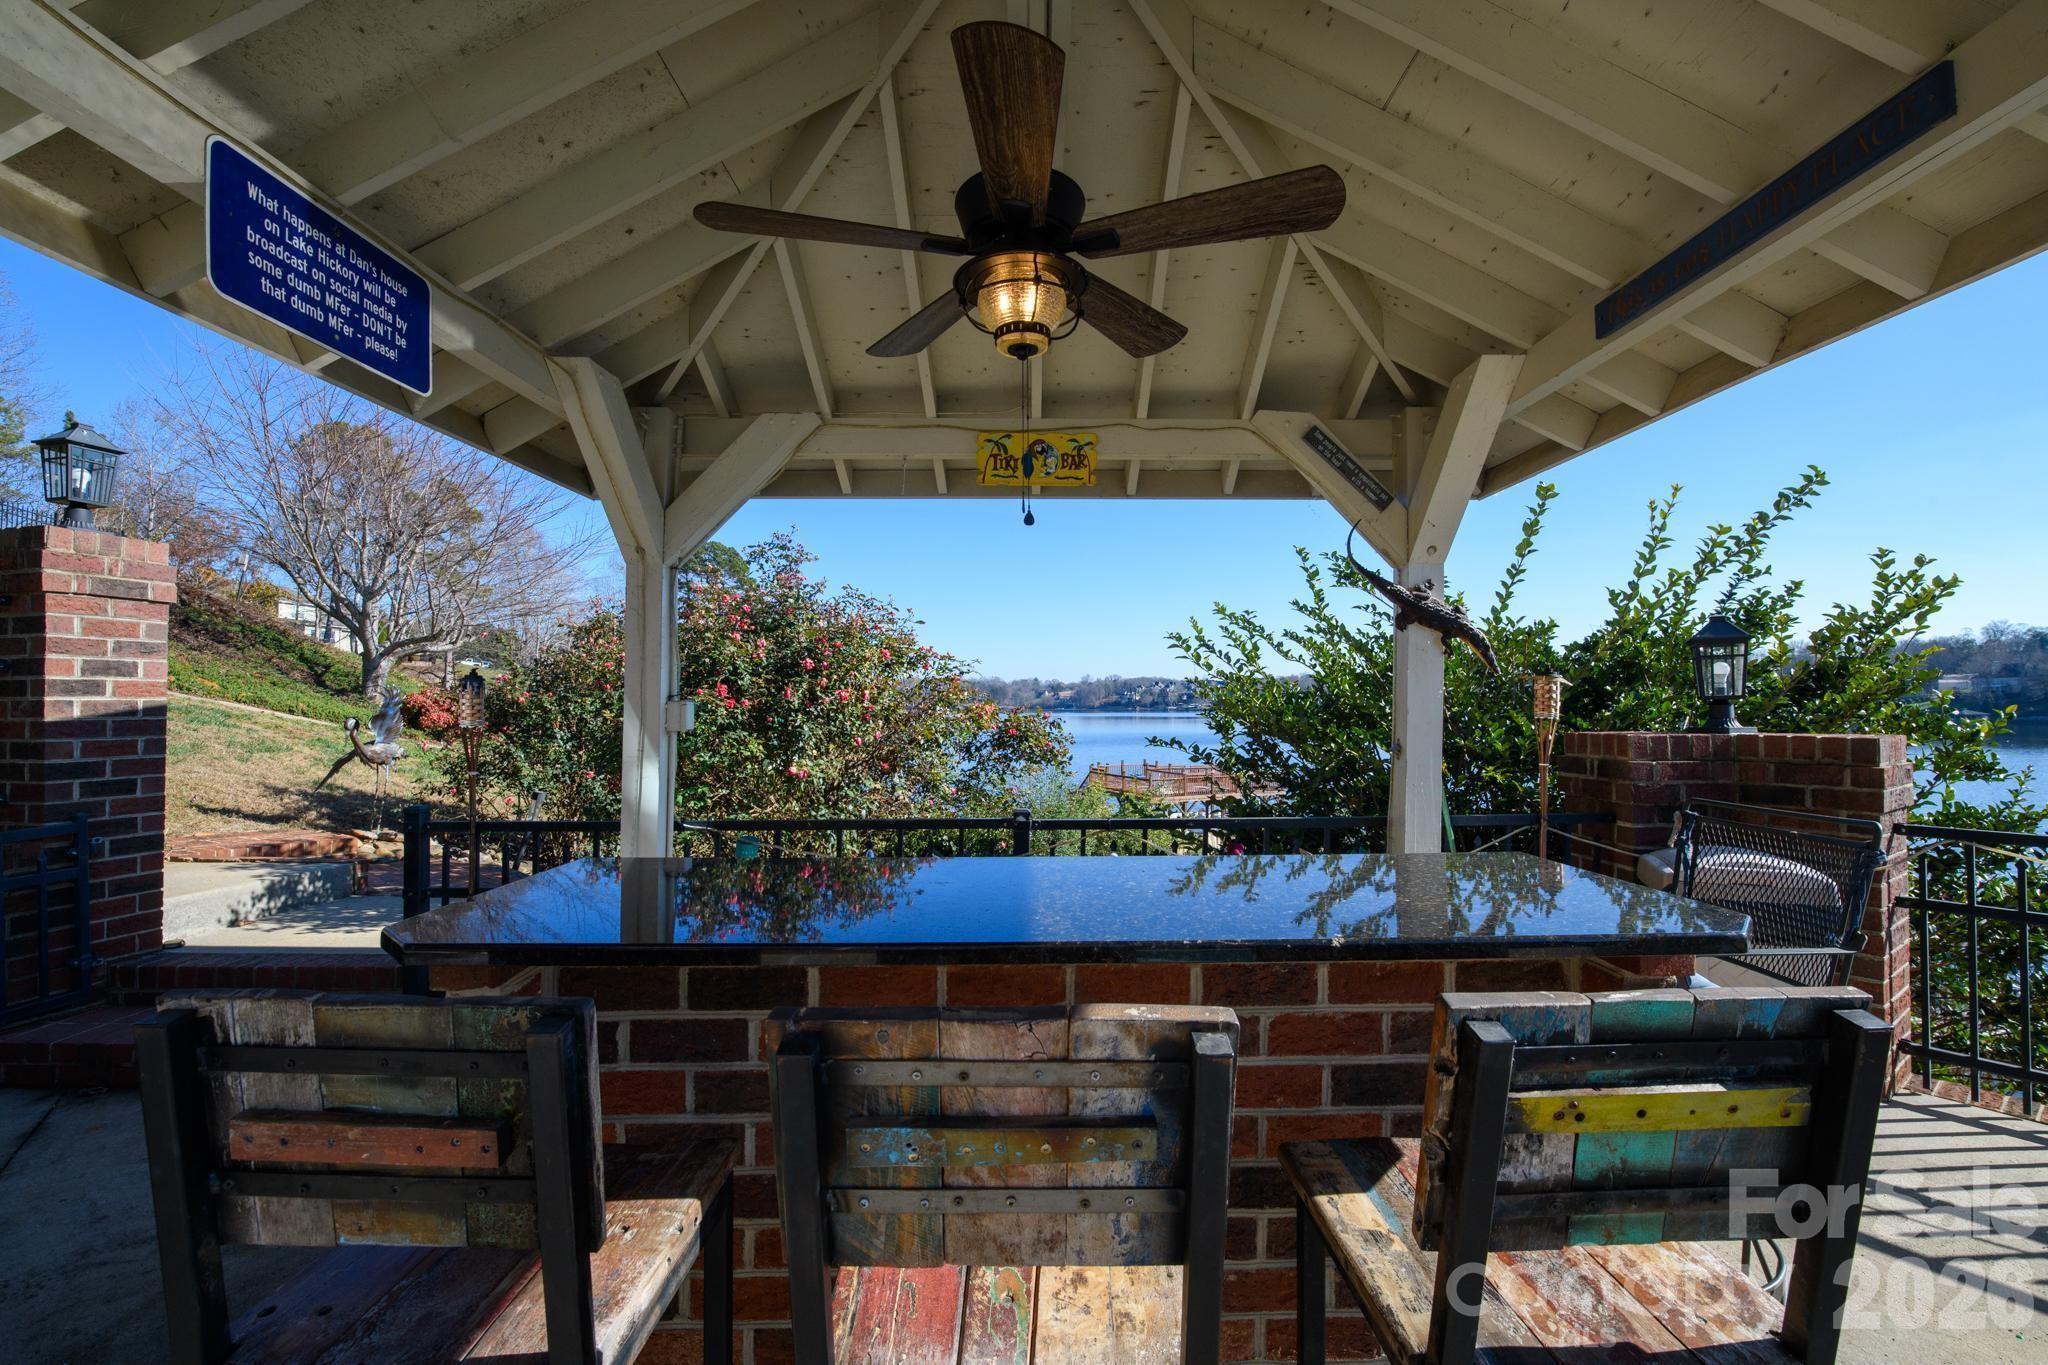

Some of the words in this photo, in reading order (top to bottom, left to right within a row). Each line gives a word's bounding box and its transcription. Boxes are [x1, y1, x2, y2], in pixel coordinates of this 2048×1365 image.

[1810, 94, 1921, 189] PLACE
[247, 225, 308, 275] broadcast
[312, 267, 326, 285] on
[330, 277, 360, 305] social
[363, 297, 393, 324] media
[396, 315, 407, 334] by
[248, 181, 278, 215] What
[284, 206, 332, 248] happens
[335, 242, 346, 258] at
[350, 251, 377, 278] Dan's
[381, 269, 408, 297] house
[264, 219, 280, 237] on
[285, 228, 313, 256] Lake
[318, 248, 359, 286] Hickory
[363, 278, 381, 299] will
[385, 290, 396, 307] be
[248, 252, 283, 280] some
[287, 271, 321, 301] dumb
[325, 296, 351, 318] MFer
[363, 313, 392, 340] DON'T
[395, 332, 407, 349] be
[261, 277, 287, 304] that
[291, 294, 324, 323] dumb
[328, 314, 354, 338] MFer
[366, 335, 398, 362] please!
[1060, 452, 1088, 470] BAR
